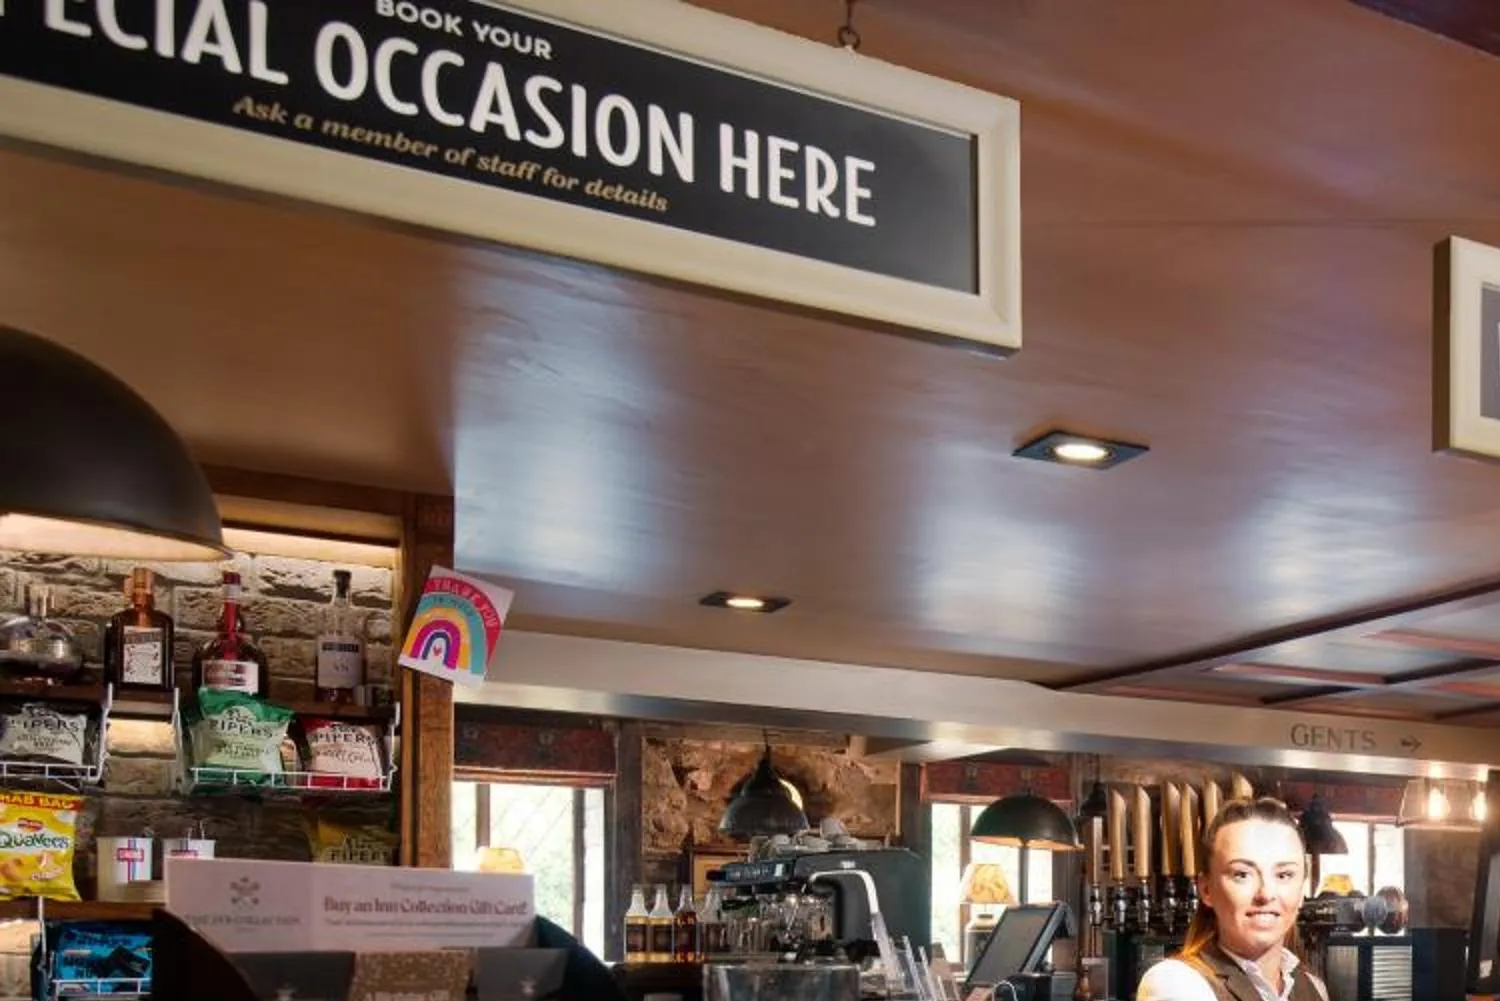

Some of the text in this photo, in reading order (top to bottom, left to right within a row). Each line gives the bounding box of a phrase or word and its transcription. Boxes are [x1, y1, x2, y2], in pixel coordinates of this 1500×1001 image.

[376, 0, 552, 60] BOOK YOUR
[315, 20, 694, 184] OCCASION
[719, 122, 877, 227] HERE
[232, 96, 670, 213] Ask a member of staff for details
[210, 718, 274, 739] PIPERS
[1290, 722, 1377, 752] GENTS
[323, 895, 352, 915] Buy
[354, 901, 374, 914] an
[400, 897, 467, 914] Collection
